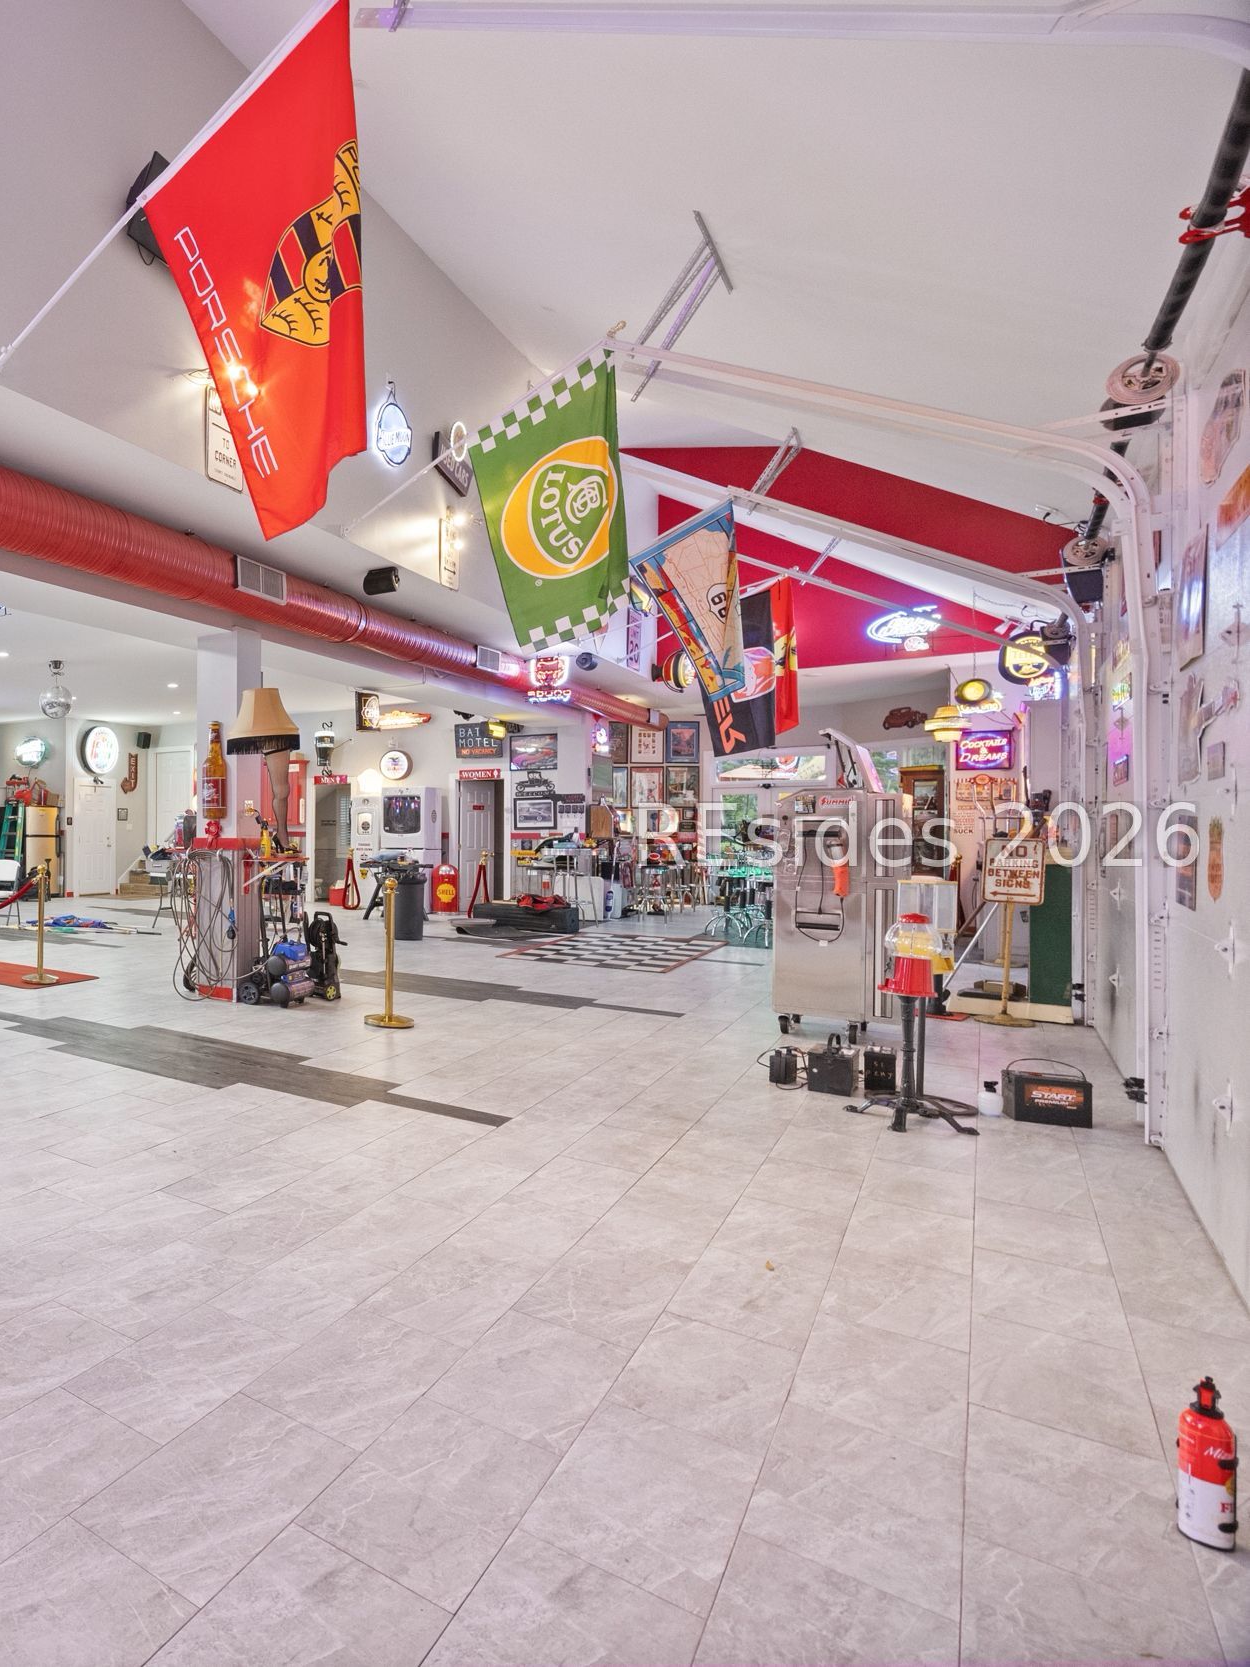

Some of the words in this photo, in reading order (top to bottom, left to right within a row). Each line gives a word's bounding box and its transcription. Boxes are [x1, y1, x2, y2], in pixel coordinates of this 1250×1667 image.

[174, 226, 278, 479] PORSCHE
[222, 437, 230, 450] TO
[394, 433, 410, 445] MOON
[214, 450, 237, 469] CORNER
[454, 462, 469, 488] CARS
[539, 470, 584, 559] LOTUS
[459, 727, 480, 738] BAT
[459, 738, 498, 748] MOTEL
[959, 737, 1008, 750] COCKTAILS
[959, 750, 1008, 763] DREAMS
[461, 770, 492, 778] WOMEN
[320, 776, 335, 784] MEN
[1001, 844, 1028, 858] NO
[989, 858, 1039, 869] PARKING
[988, 868, 1040, 878] BETWEEN
[994, 879, 1031, 889] SIGNS
[437, 888, 455, 896] SHELL
[1033, 1098, 1070, 1106] PREMIUM
